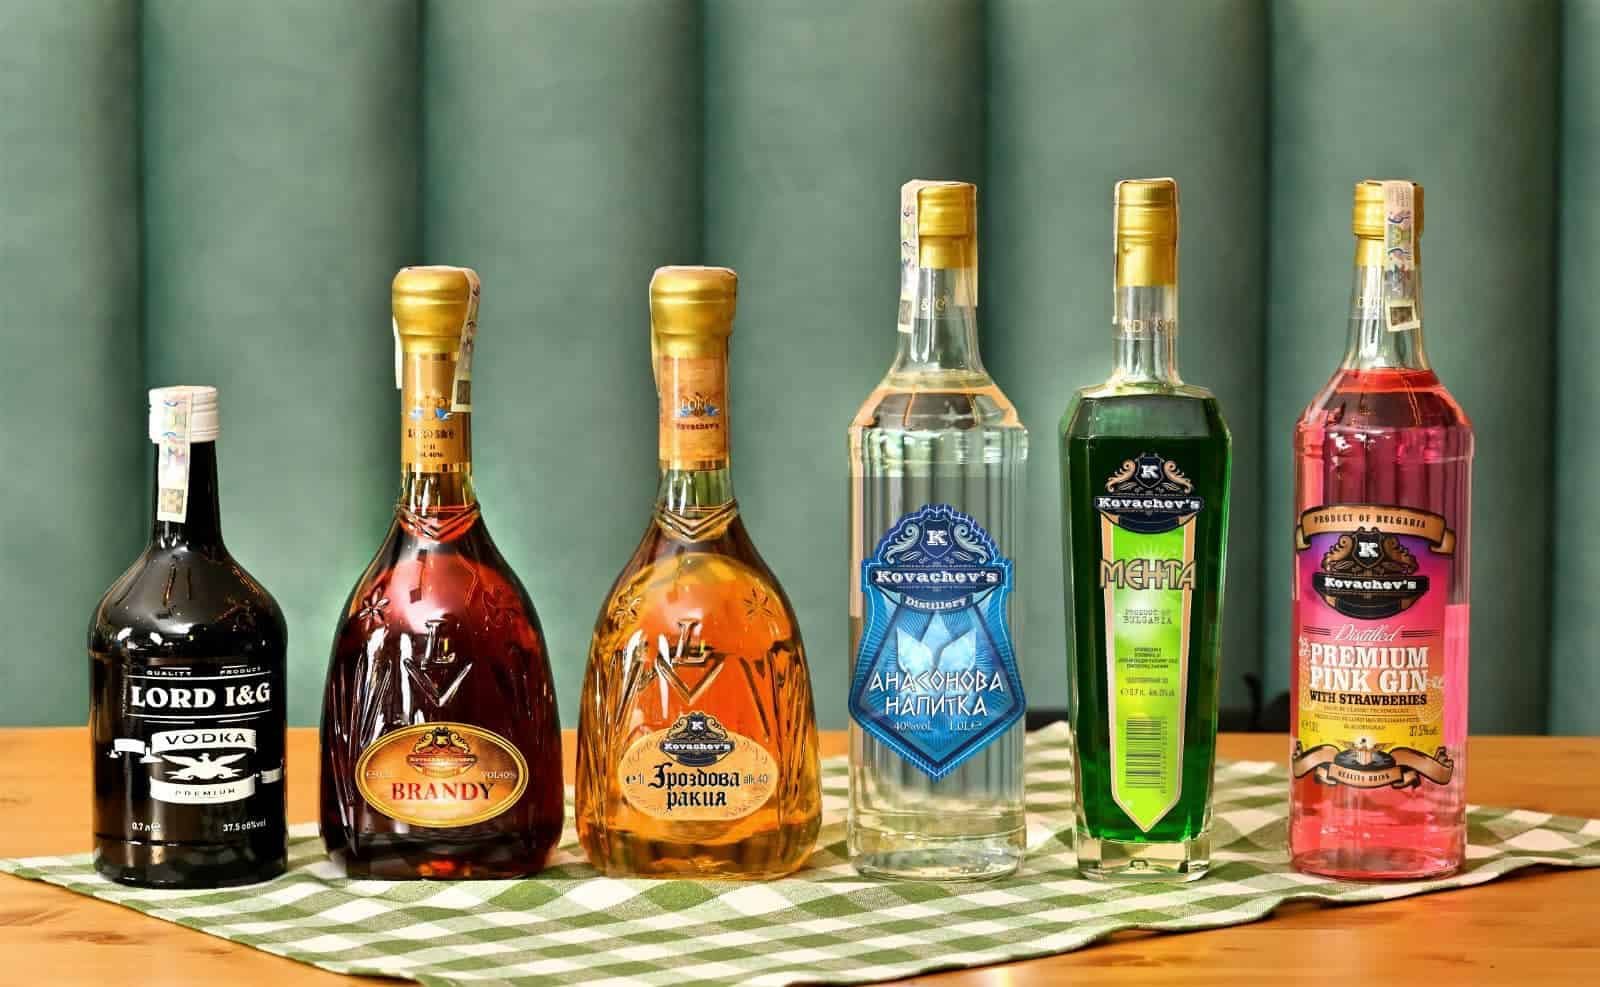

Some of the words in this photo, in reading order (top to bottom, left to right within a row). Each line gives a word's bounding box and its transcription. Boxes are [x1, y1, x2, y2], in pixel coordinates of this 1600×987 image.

[1140, 464, 1159, 479] K
[1099, 497, 1200, 510] Kovachev's
[1314, 514, 1353, 524] PRODUCT
[1359, 515, 1371, 523] OF
[926, 530, 948, 546] K
[1358, 541, 1379, 558] K
[875, 570, 999, 584] Kovachev's
[1324, 577, 1417, 590] Kovachev's
[905, 596, 967, 610] Distillery
[1334, 624, 1402, 642] Distilled
[1310, 643, 1429, 669] PREMIUM
[869, 671, 1004, 692] АНАСОНОВА
[1309, 666, 1371, 692] PINK
[1379, 669, 1428, 693] GIN
[131, 686, 216, 708] LORD
[224, 682, 270, 707] I&G
[1310, 690, 1336, 704] WITH
[885, 695, 988, 718] НАПИТКА
[691, 721, 704, 731] K
[165, 732, 248, 745] VODKA
[663, 741, 732, 751] Kovachev's
[175, 788, 236, 798] PREMIUM
[391, 782, 495, 801] BRANDY
[667, 790, 727, 811] ракия
[223, 822, 240, 832] 37.5
